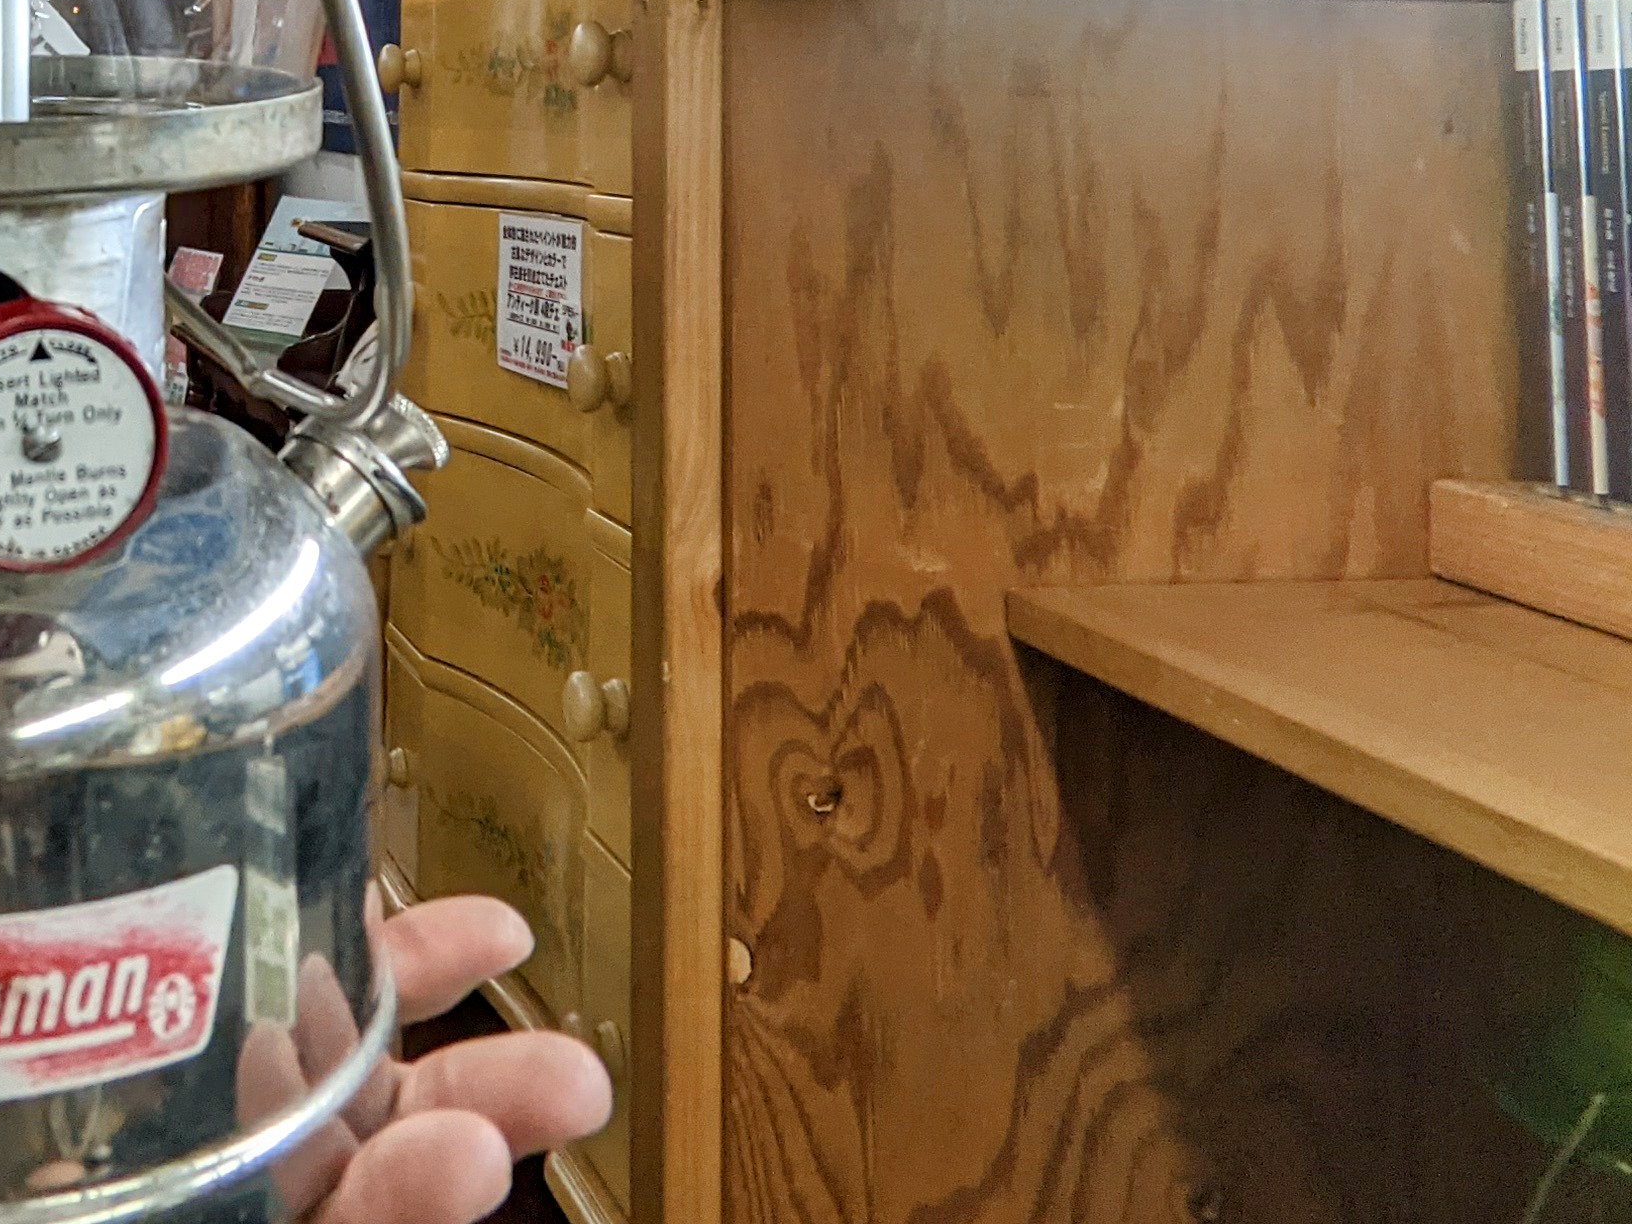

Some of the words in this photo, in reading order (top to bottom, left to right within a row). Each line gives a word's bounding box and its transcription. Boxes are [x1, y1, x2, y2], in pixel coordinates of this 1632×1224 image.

[15, 391, 68, 408] Match
[83, 404, 121, 426] Only
[45, 487, 89, 505] Open
